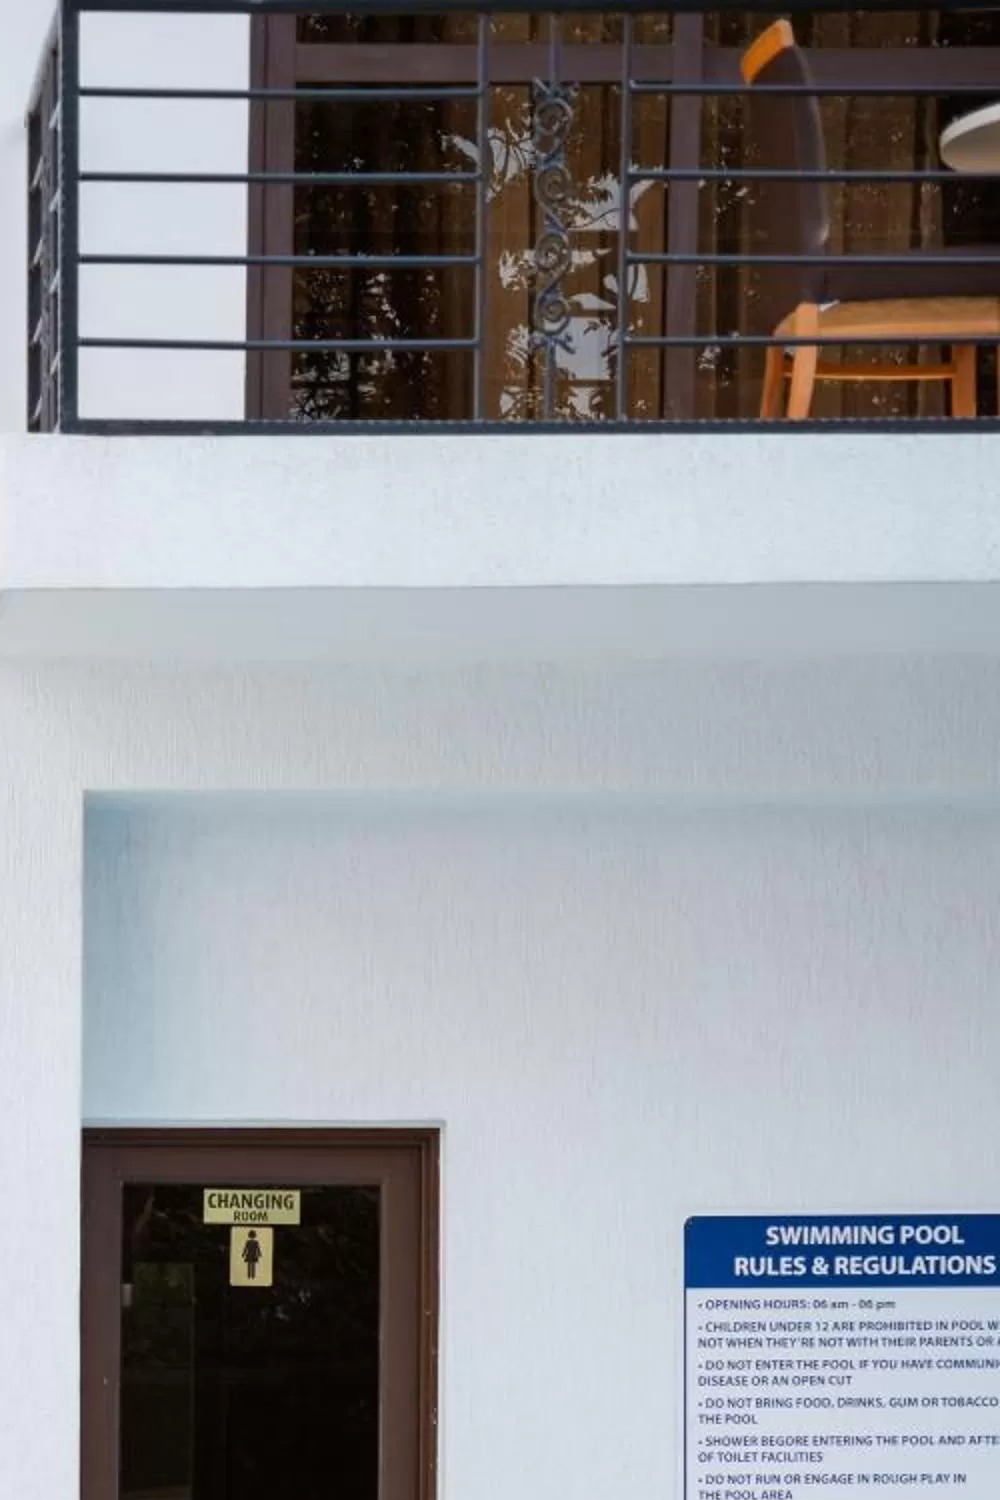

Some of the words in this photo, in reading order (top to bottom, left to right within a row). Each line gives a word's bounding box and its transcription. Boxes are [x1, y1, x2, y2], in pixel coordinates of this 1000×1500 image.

[207, 1193, 294, 1209] CHANGING
[233, 1211, 268, 1221] ROOM
[766, 1226, 895, 1244] SWIMMING
[900, 1226, 964, 1244] POOL
[734, 1257, 806, 1276] RULES
[811, 1257, 829, 1275] &
[834, 1256, 996, 1274] REGULATIONS
[705, 1300, 760, 1309] OPENING
[763, 1300, 811, 1309] HOURS:
[812, 1300, 828, 1309] 06
[858, 1300, 873, 1309] 06
[875, 1301, 896, 1311] pm
[705, 1322, 766, 1332] CHILDREN
[769, 1322, 812, 1332] UNDER
[816, 1321, 829, 1332] 12
[832, 1321, 855, 1331] ARE
[858, 1321, 933, 1331] PROHIBITED
[935, 1321, 948, 1330] IN
[951, 1320, 984, 1330] POOL
[698, 1338, 723, 1348] NOT
[726, 1338, 763, 1348] WHEN
[766, 1337, 815, 1348] THEY'RE
[818, 1337, 843, 1347] NOT
[846, 1337, 879, 1347] WITH
[881, 1337, 917, 1347] THEIR
[919, 1336, 973, 1346] PARENTS
[975, 1336, 994, 1346] OR
[705, 1360, 724, 1370] DO
[727, 1360, 751, 1370] NOT
[755, 1360, 794, 1370] ENTER
[796, 1360, 819, 1370] THE
[822, 1360, 855, 1370] POOL
[859, 1360, 870, 1368] IF
[872, 1360, 898, 1369] YOU
[901, 1360, 933, 1368] HAVE
[936, 1359, 1000, 1368] COMMUNI
[698, 1376, 748, 1386] DISEASE
[751, 1376, 768, 1386] OR
[771, 1376, 789, 1385] AN
[792, 1376, 825, 1386] OPEN
[828, 1376, 852, 1385] CUT
[705, 1398, 724, 1408] DO
[727, 1398, 752, 1408] NOT
[755, 1398, 793, 1408] BRING
[796, 1397, 834, 1408] FOOD,
[837, 1398, 886, 1408] DRINKS,
[889, 1398, 918, 1407] GUM
[921, 1397, 939, 1407] OR
[941, 1397, 999, 1407] TOBACCO
[699, 1414, 722, 1424] THE
[725, 1414, 758, 1424] POOL
[705, 1436, 758, 1446] SHOWER
[761, 1436, 809, 1446] BEGORE
[812, 1436, 873, 1446] ENTERING
[875, 1436, 898, 1445] THE
[902, 1436, 934, 1446] POOL
[938, 1436, 966, 1445] AND
[698, 1452, 715, 1462] OF
[717, 1452, 758, 1462] TOILET
[761, 1452, 823, 1462] FACILITIES
[705, 1474, 724, 1484] DO
[727, 1474, 751, 1484] NOT
[755, 1474, 781, 1484] RUN
[784, 1474, 801, 1484] OR
[804, 1474, 854, 1484] ENGAGE
[857, 1474, 870, 1483] IN
[873, 1474, 918, 1484] ROUGH
[920, 1474, 951, 1484] PLAY
[953, 1474, 967, 1483] IN
[699, 1490, 722, 1500] THE
[724, 1490, 758, 1500] POOL
[760, 1490, 793, 1500] AREA
